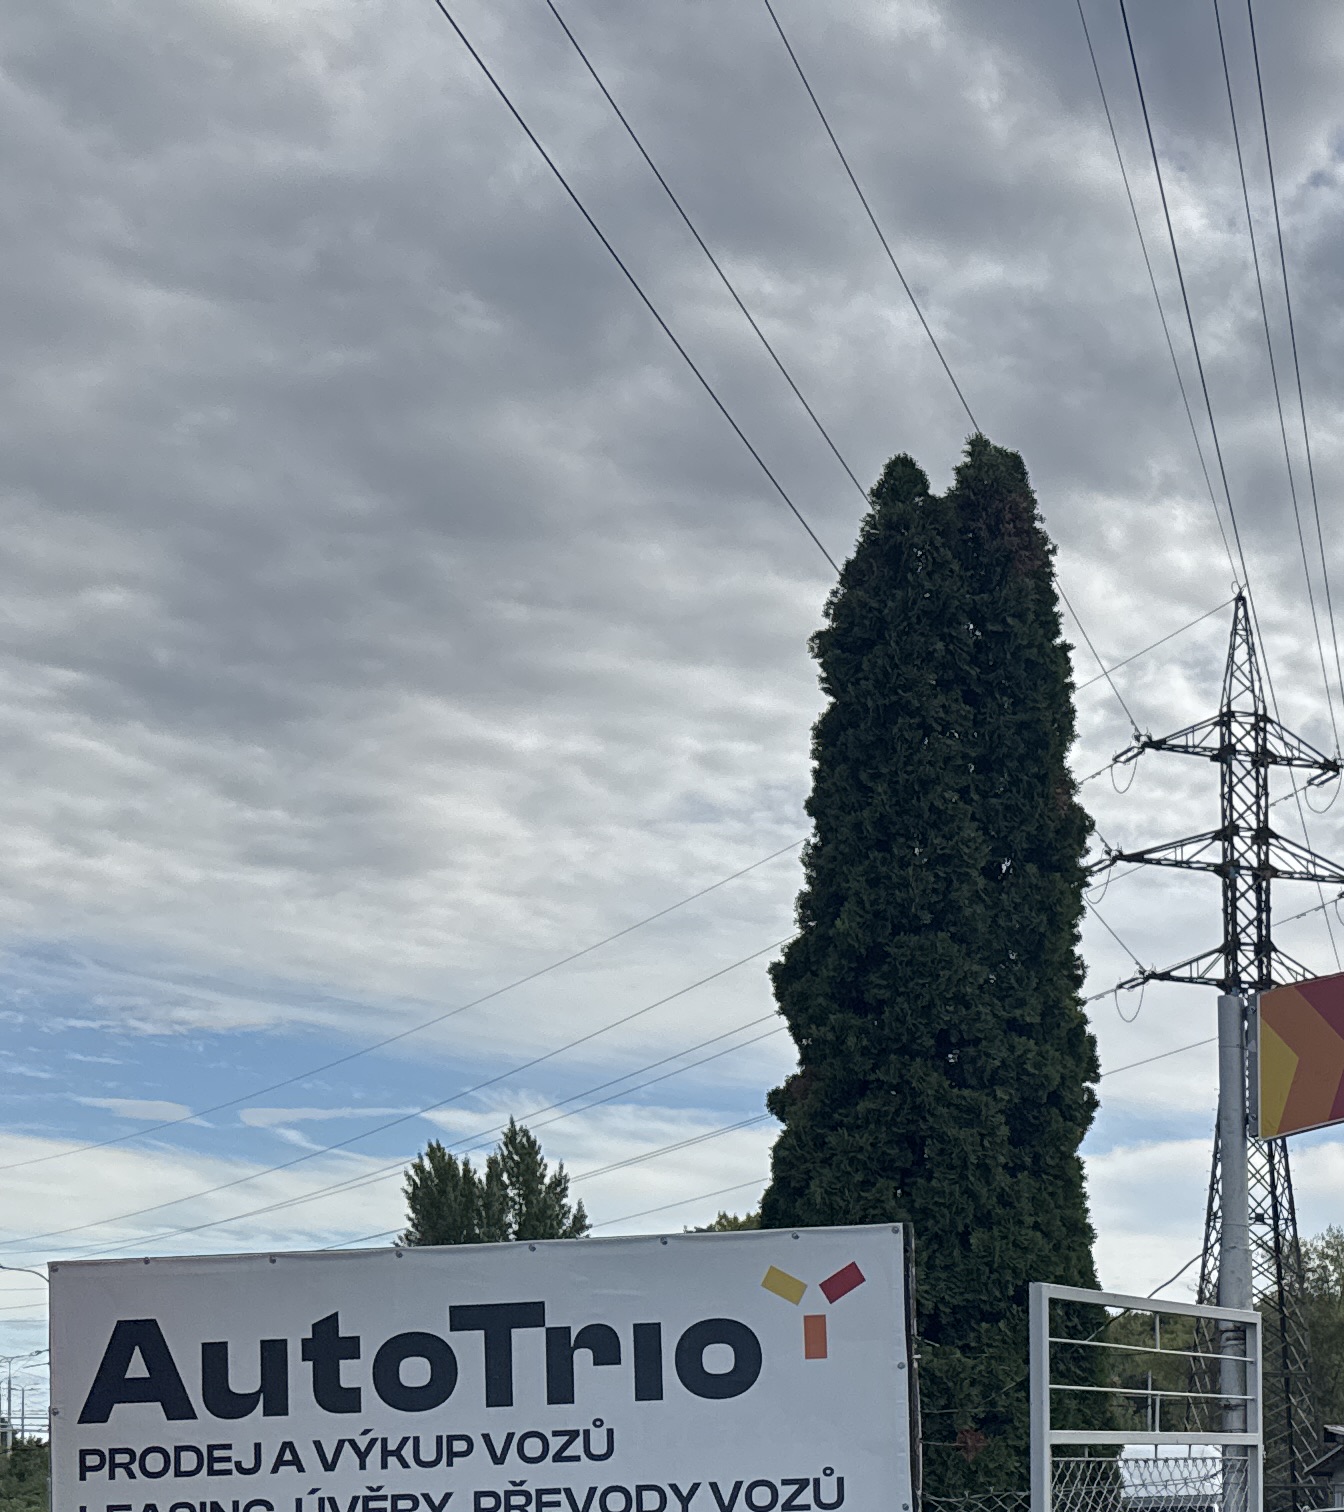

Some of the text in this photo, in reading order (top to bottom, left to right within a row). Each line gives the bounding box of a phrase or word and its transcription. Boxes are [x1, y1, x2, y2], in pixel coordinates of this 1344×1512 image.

[77, 1300, 762, 1425] AutoTrio
[79, 1417, 615, 1481] PRODEJ A VÝKUP VOZŮ
